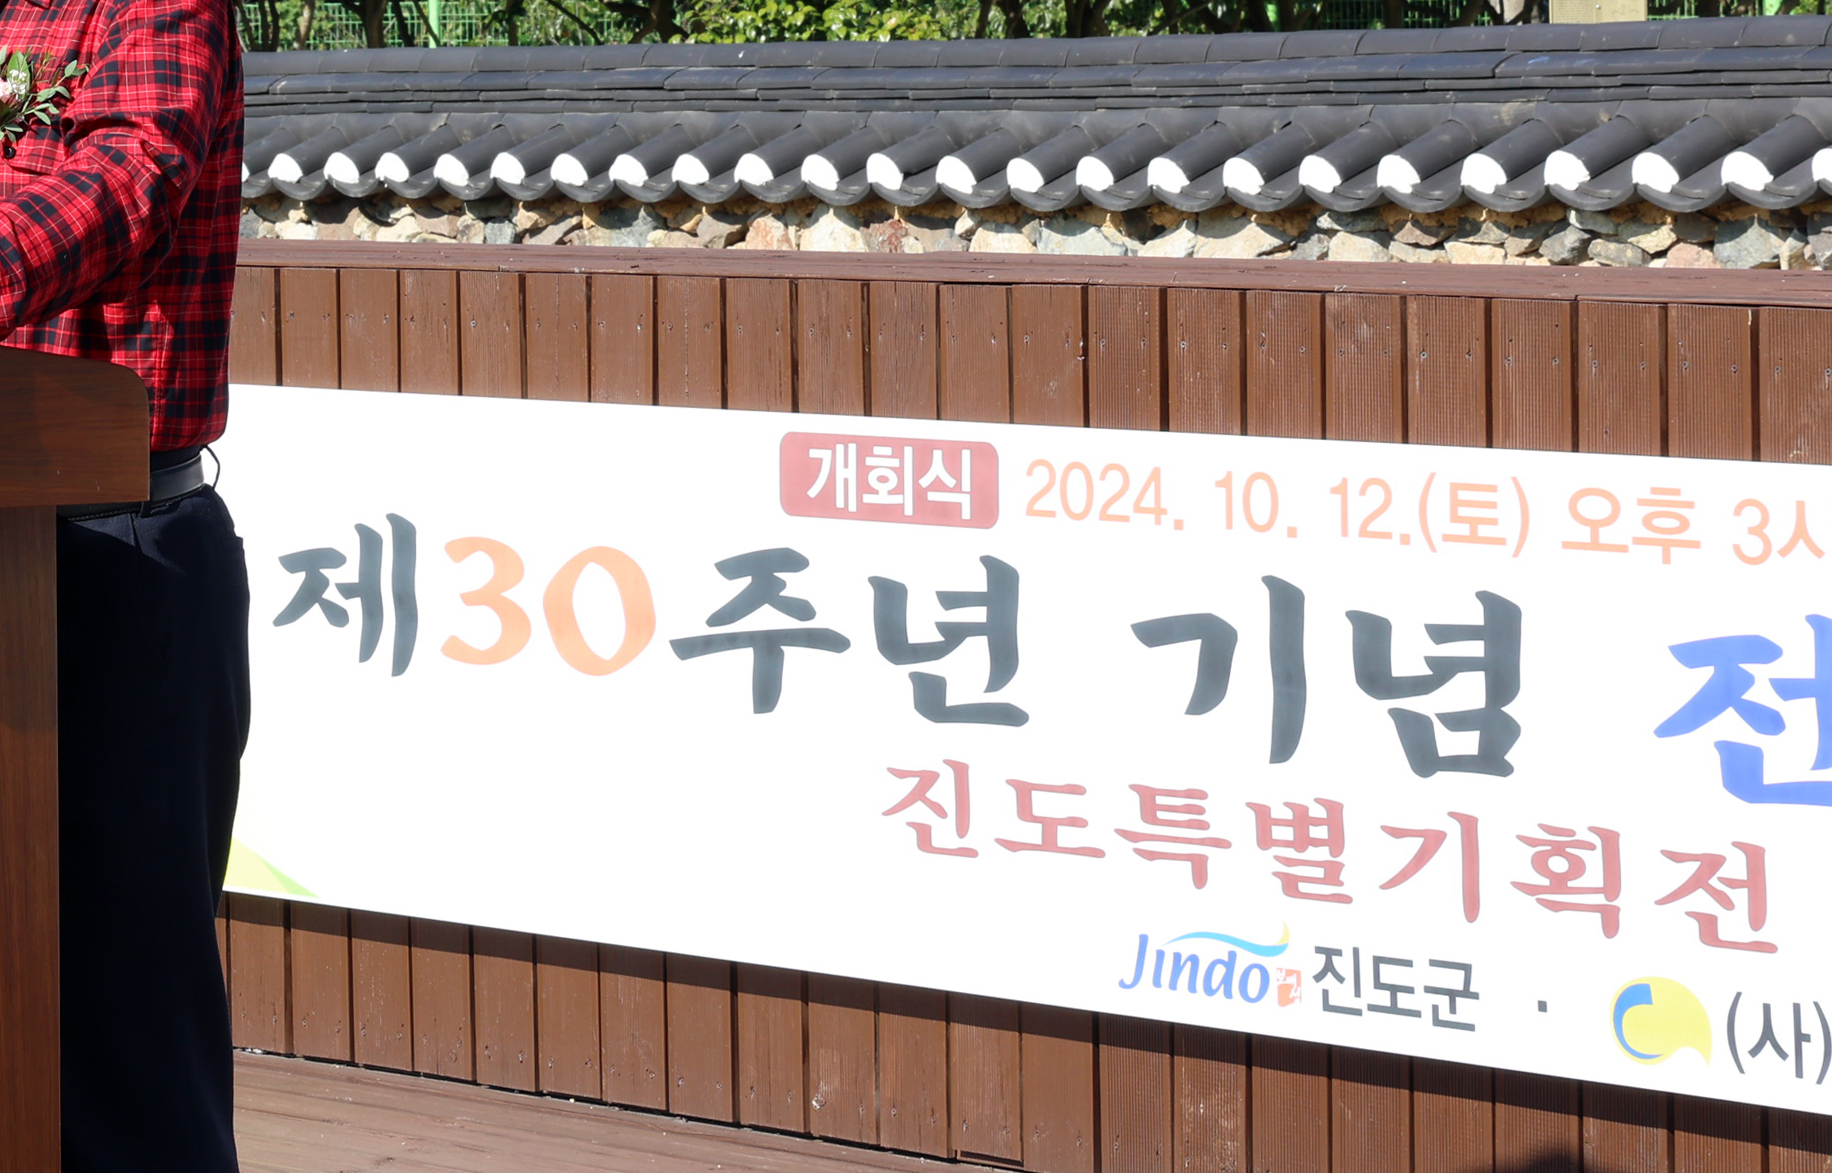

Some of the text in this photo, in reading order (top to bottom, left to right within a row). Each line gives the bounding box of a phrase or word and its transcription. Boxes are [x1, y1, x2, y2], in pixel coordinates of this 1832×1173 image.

[806, 442, 972, 520] 개회식
[1025, 458, 1184, 531] 2024.
[1214, 470, 1298, 539] 10.
[1561, 486, 1702, 565] 오후
[272, 513, 1030, 728] 제30주년
[1130, 575, 1522, 778] 기념
[882, 759, 1779, 954] 진도특별기획전
[1118, 933, 1271, 1004] Jindo
[1312, 946, 1480, 1032] 진도군
[1726, 991, 1832, 1085] (사)
